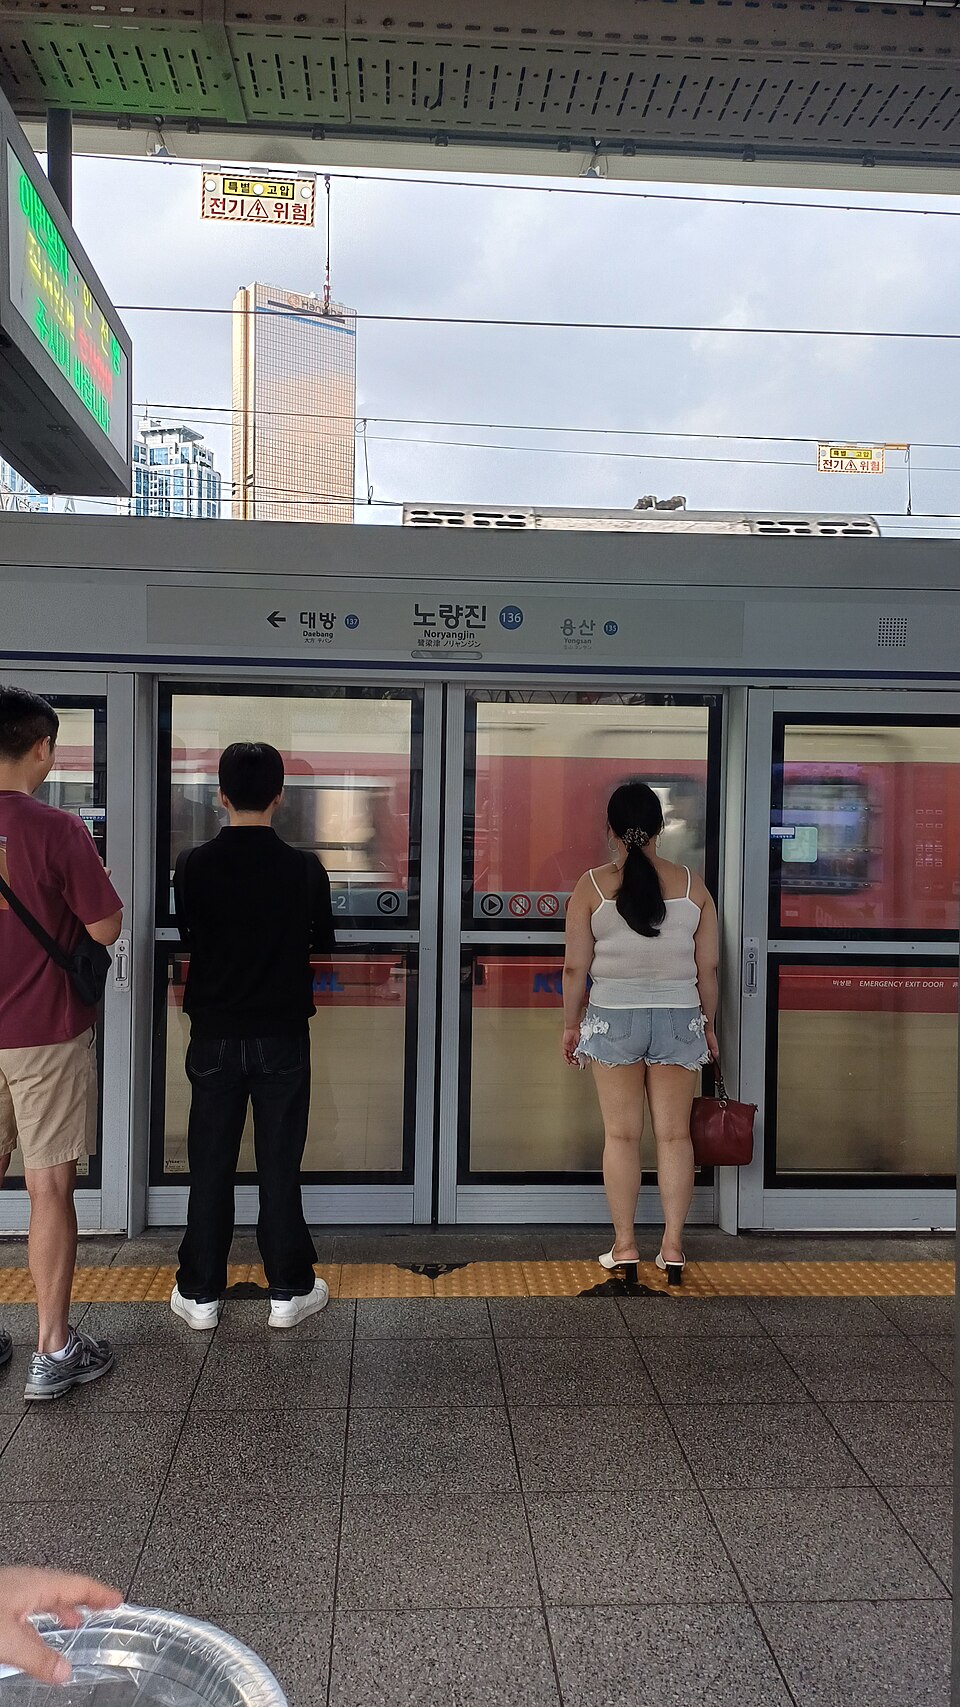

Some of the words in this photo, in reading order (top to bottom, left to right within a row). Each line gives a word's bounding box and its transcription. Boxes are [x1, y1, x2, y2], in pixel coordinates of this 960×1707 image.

[228, 182, 250, 193] 특별
[267, 185, 290, 196] 고압
[210, 198, 244, 216] 전기
[273, 202, 307, 220] 위험
[823, 460, 843, 469] 전기
[860, 461, 879, 471] 위험
[300, 612, 336, 630] 대방
[345, 617, 358, 626] 137
[413, 604, 487, 629] 노량진
[501, 612, 521, 623] 136
[560, 618, 596, 636] 용산
[605, 624, 617, 632] 135
[303, 630, 333, 639] Daebang
[424, 630, 475, 640] Noryangjin
[564, 637, 592, 645] Yongsan
[859, 980, 902, 988] EMERGENCY
[415, 1264, 447, 1272] 7-2
